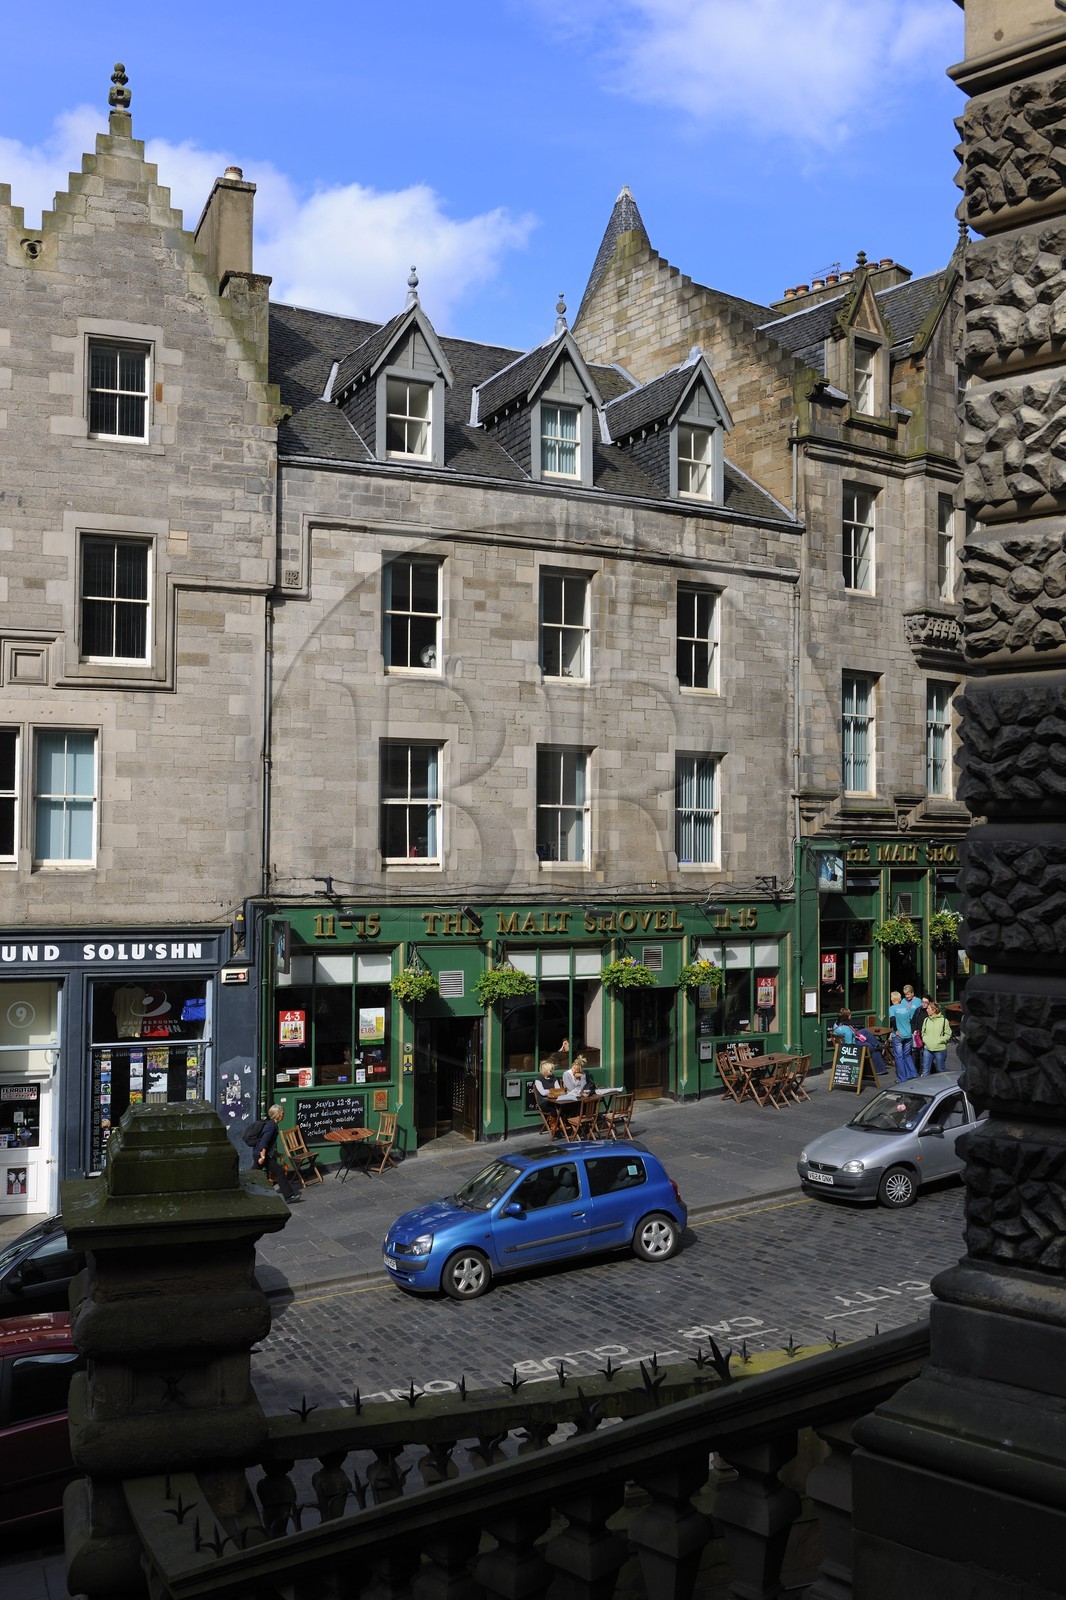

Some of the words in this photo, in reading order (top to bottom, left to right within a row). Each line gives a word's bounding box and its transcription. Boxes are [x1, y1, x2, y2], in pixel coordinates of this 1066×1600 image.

[877, 844, 919, 861] MALT
[313, 912, 381, 937] 11-15
[421, 911, 483, 935] THE
[496, 911, 572, 936] MALT
[583, 908, 684, 933] SHOVEL
[714, 906, 758, 930] 11-15
[83, 943, 202, 960] SOLU'SHN
[15, 1007, 27, 1021] 9
[284, 1011, 301, 1022] 4-3
[840, 1045, 858, 1056] SALE
[834, 1280, 931, 1306] CITY
[677, 1315, 765, 1340] CAR
[512, 1343, 629, 1374] CLUB
